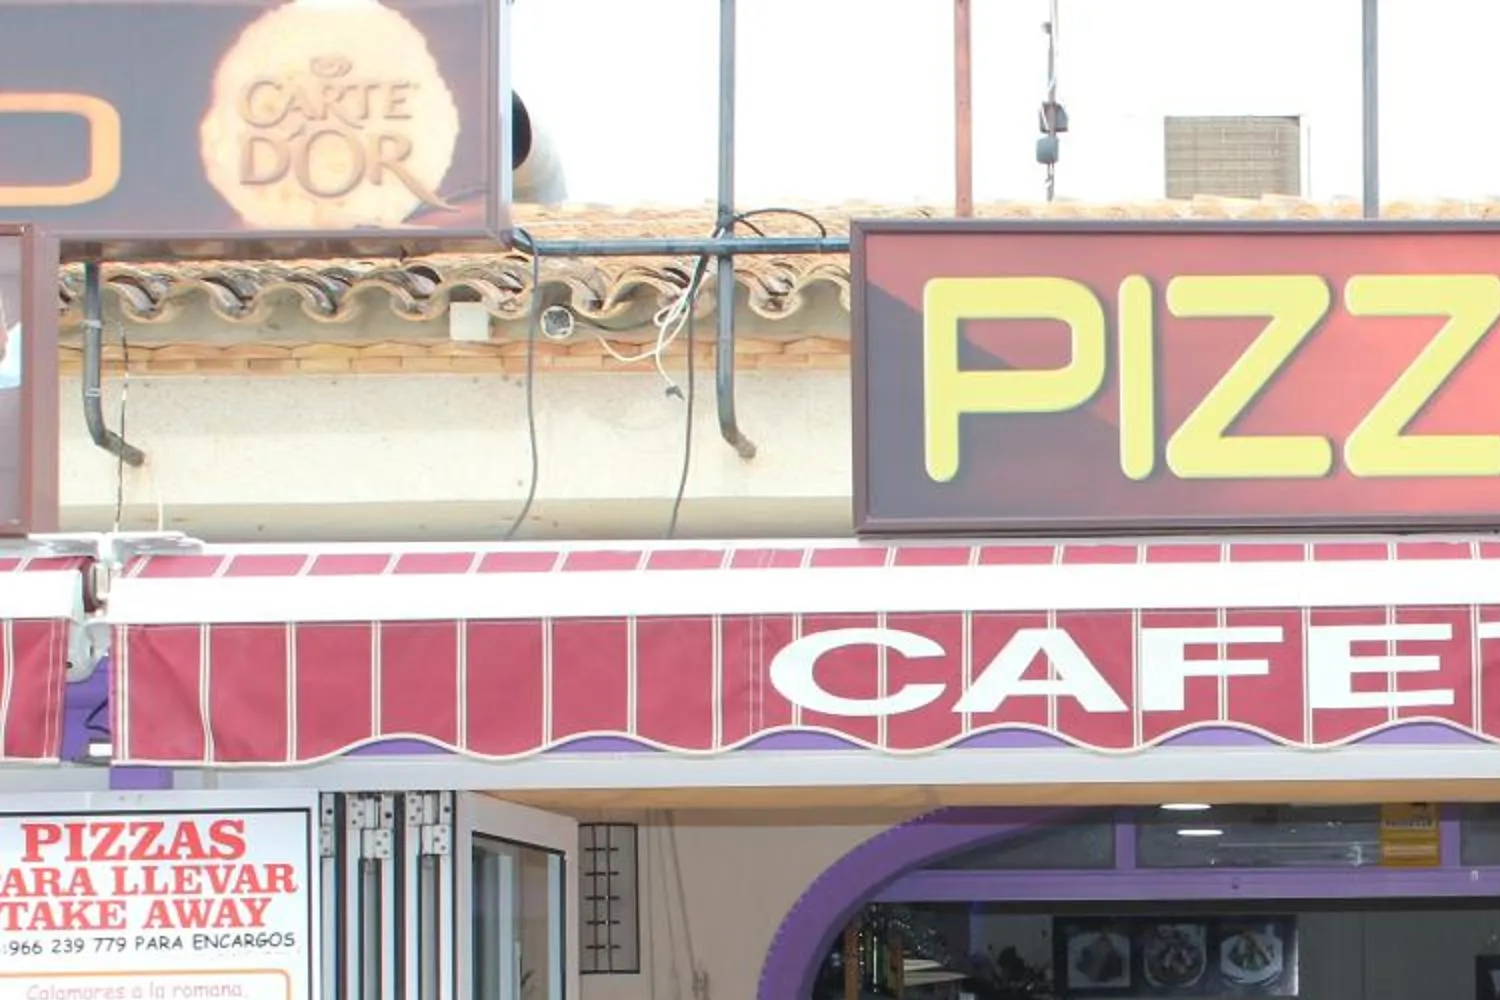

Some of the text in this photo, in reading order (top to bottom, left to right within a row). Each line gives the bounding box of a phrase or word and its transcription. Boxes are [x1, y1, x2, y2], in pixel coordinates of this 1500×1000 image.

[240, 80, 413, 129] CARTE
[20, 819, 246, 862] PIZZAS
[0, 863, 298, 898] ARA LLEVAR
[0, 897, 273, 931] TAKE AWAY
[9, 931, 295, 956] 966 239 779 PARA ENCARGOS
[131, 985, 144, 1000] a
[149, 980, 166, 1000] la
